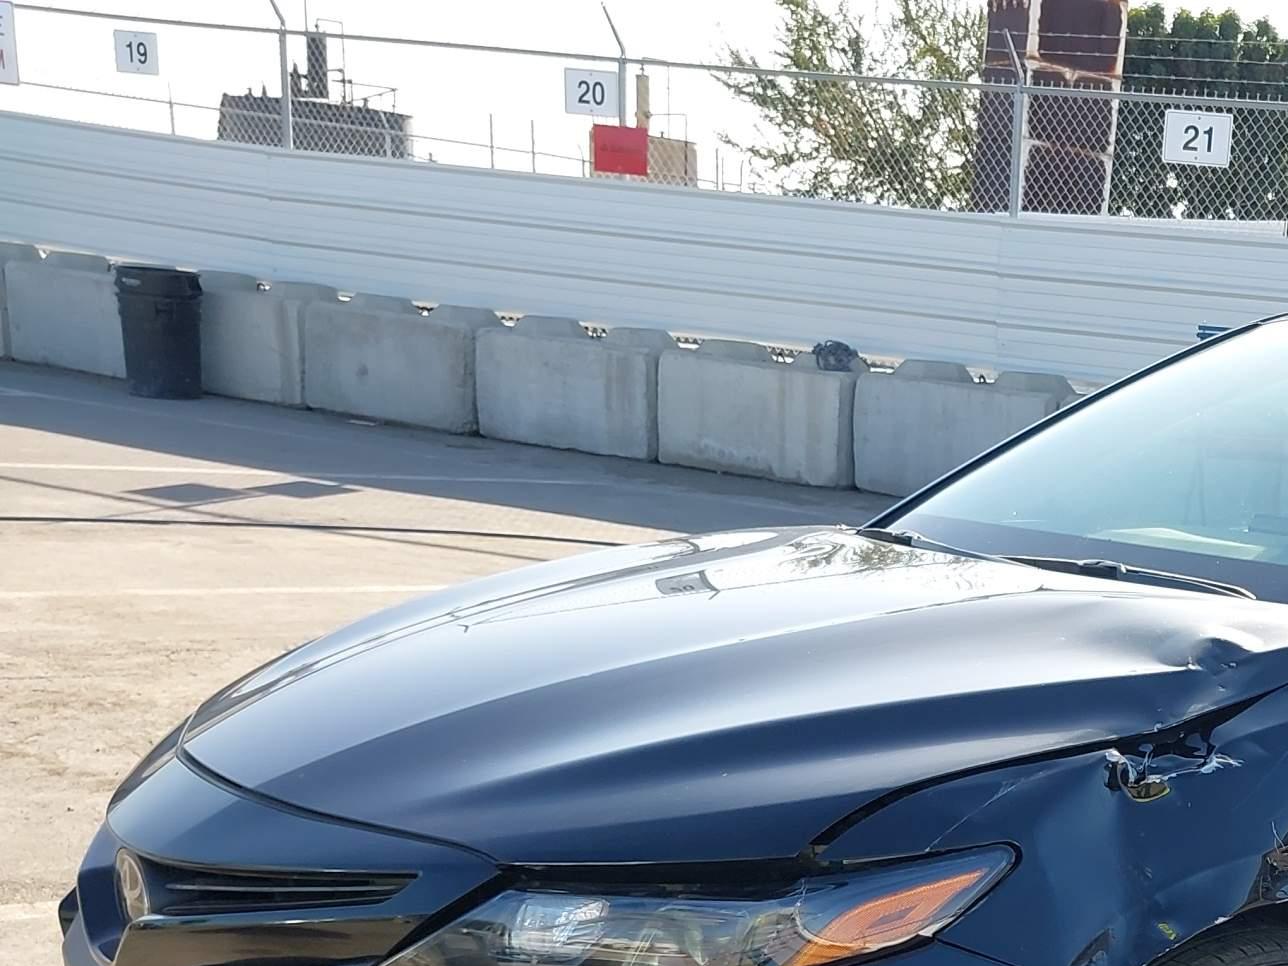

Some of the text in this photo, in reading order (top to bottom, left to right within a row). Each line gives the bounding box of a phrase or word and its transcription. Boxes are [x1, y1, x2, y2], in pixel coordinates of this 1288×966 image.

[125, 41, 148, 65] 19
[577, 80, 605, 106] 20
[1182, 124, 1214, 153] 21
